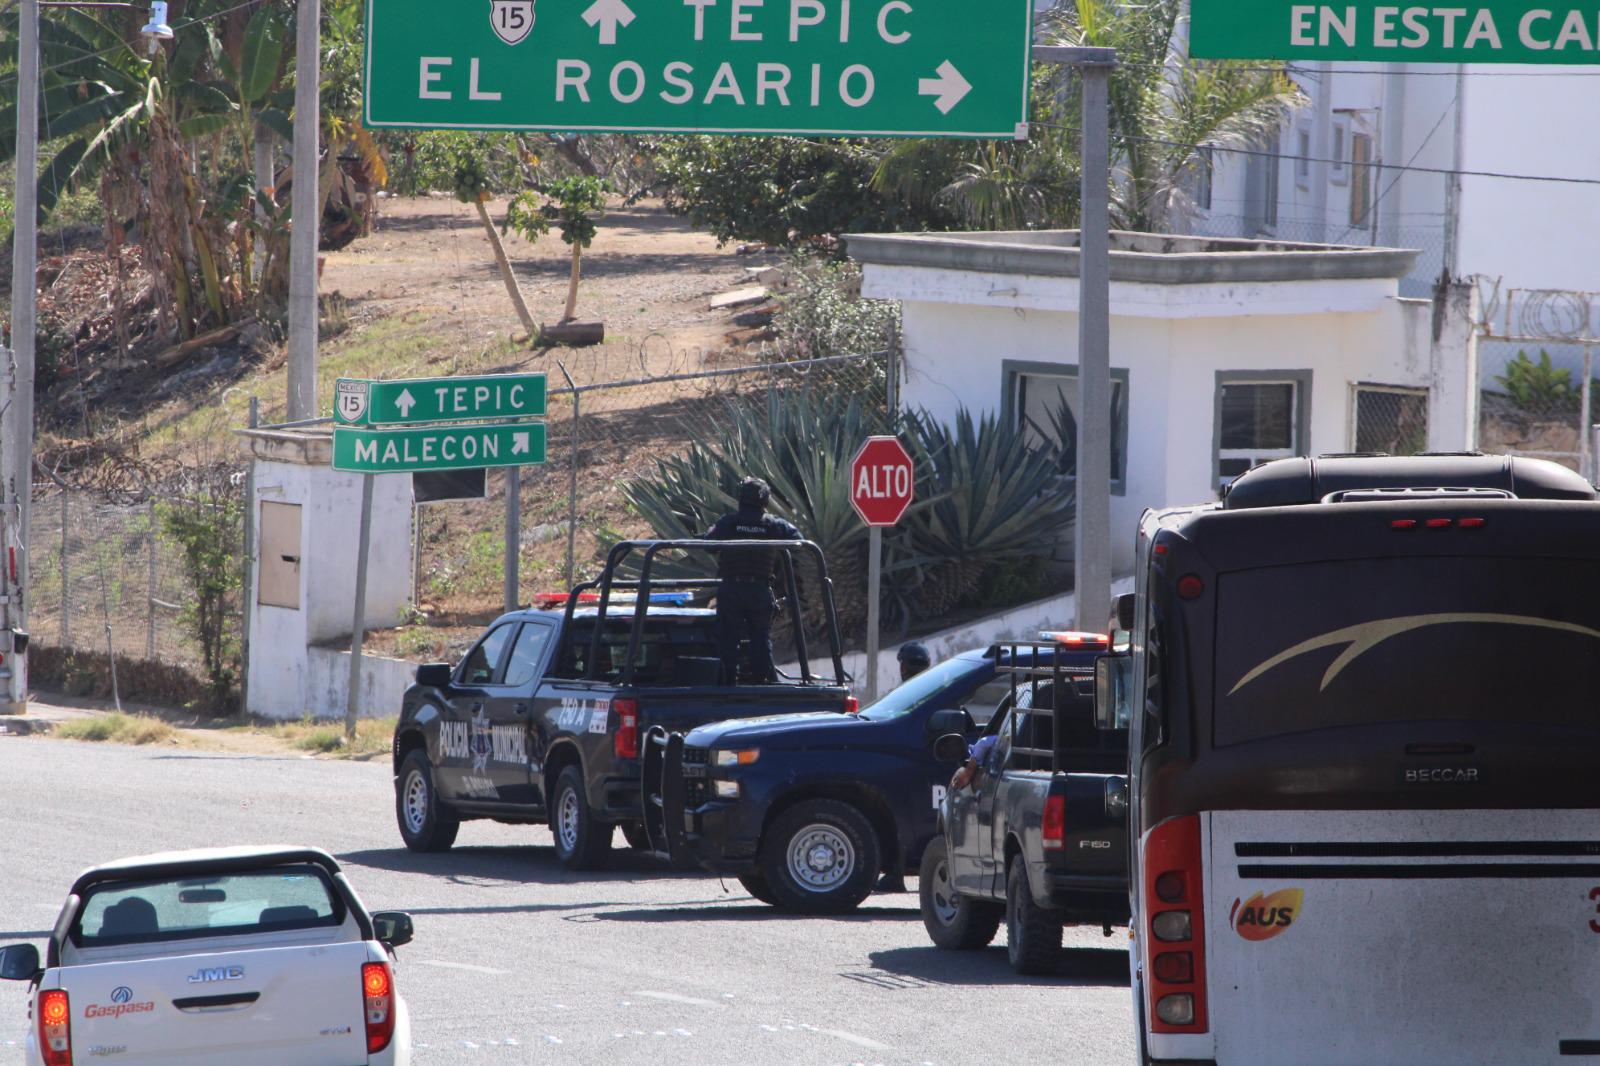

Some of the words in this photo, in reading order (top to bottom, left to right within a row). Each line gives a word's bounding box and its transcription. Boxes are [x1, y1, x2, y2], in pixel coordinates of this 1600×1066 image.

[501, 6, 525, 29] 15
[683, 0, 913, 44] TEPIC
[1290, 5, 1357, 47] EN
[1373, 7, 1502, 49] ESTA
[1518, 9, 1600, 51] CA
[418, 56, 502, 101] EL
[555, 59, 876, 107] ROSARIO
[344, 396, 360, 412] 15
[434, 384, 525, 413] TEPIC
[354, 433, 499, 464] MALECON
[855, 464, 910, 499] ALTO
[1405, 768, 1479, 781] BECCAR
[1239, 906, 1293, 927] AUS
[188, 966, 244, 983] JMC
[84, 1001, 155, 1018] Gaspasa
